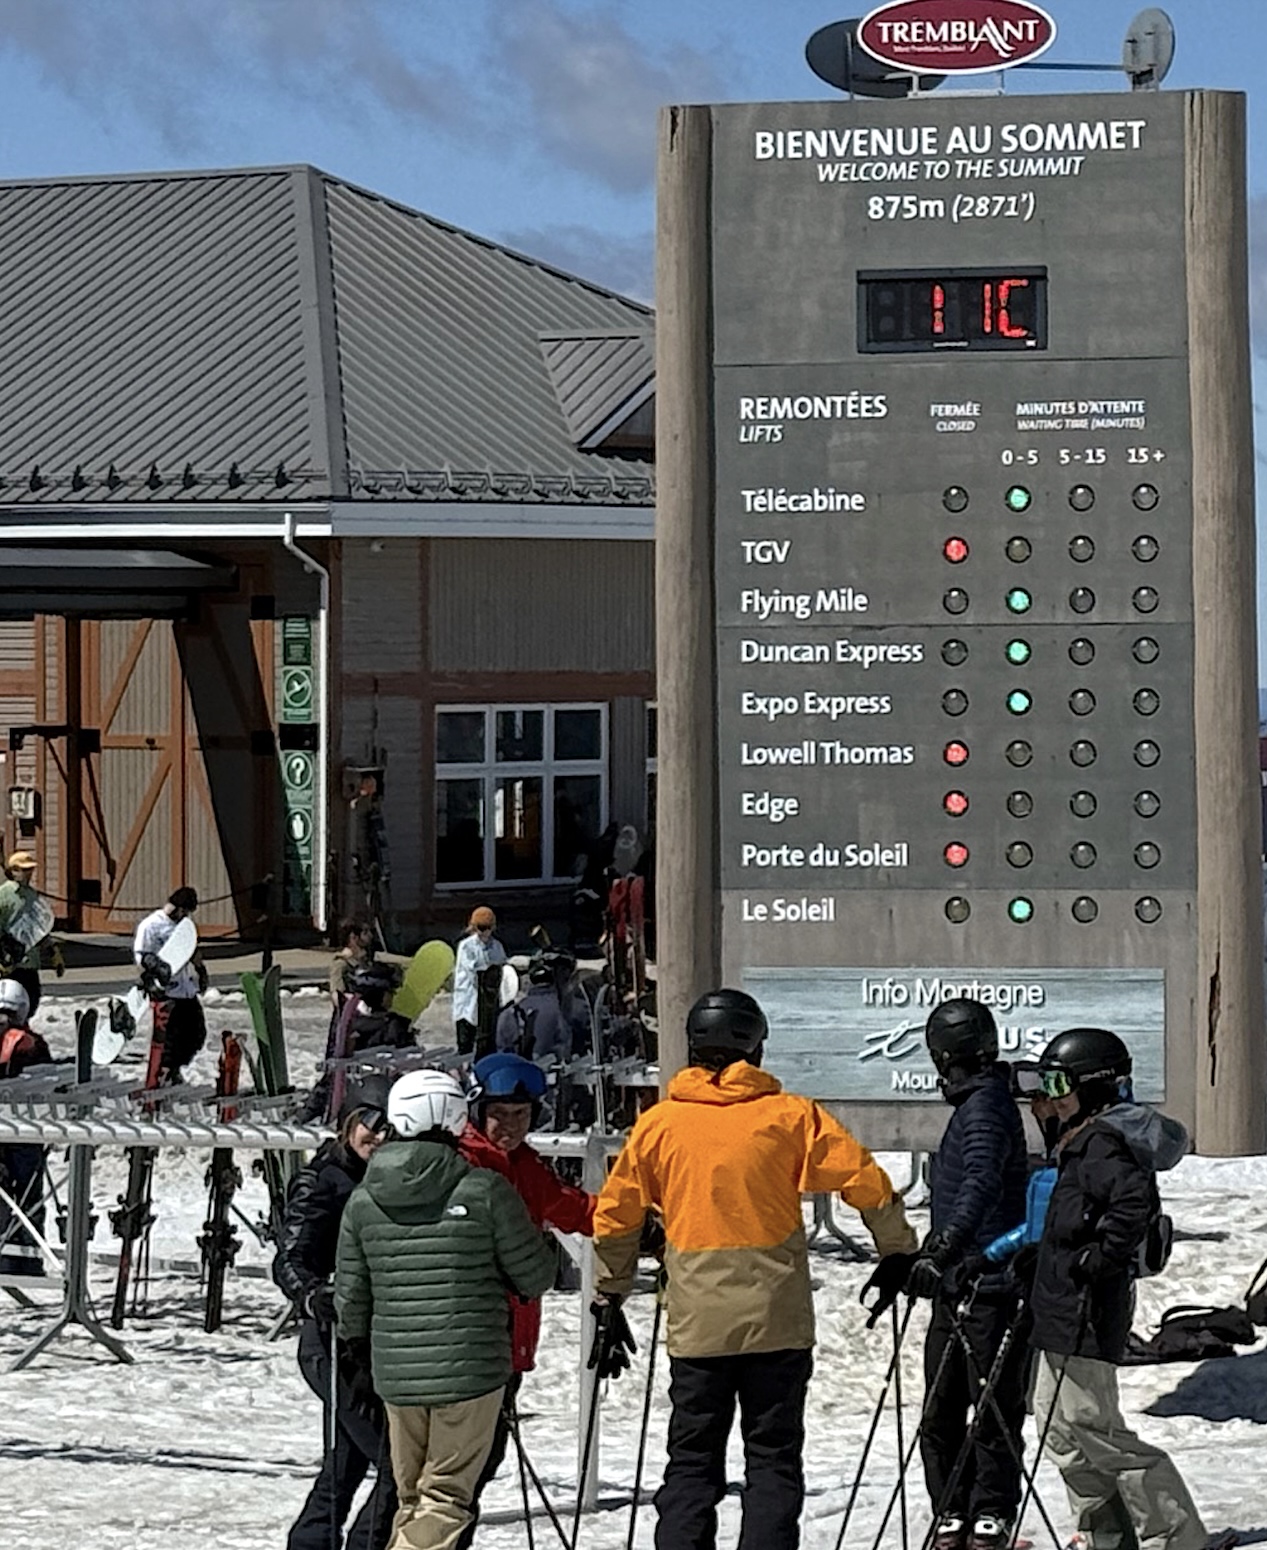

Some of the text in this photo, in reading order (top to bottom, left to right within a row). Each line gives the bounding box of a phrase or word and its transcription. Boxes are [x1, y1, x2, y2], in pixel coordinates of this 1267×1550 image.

[878, 17, 1040, 57] TREMBLANT
[755, 120, 1146, 161] BIENVENUE AU SOMMET
[817, 156, 1085, 182] WELCOME TO THE SUMMIT
[867, 195, 945, 219] 875m
[740, 390, 888, 420] REMONTÉES
[930, 401, 980, 417] FERMÉE
[1016, 401, 1076, 416] MINUTES
[739, 424, 783, 443] LIFTS
[935, 420, 976, 432] CLOSED
[1017, 418, 1063, 430] WAITING
[740, 487, 865, 512] Télécabine
[740, 540, 791, 563] TGV
[741, 587, 868, 620] Flying Mile
[741, 639, 923, 669] Duncan Express
[741, 691, 891, 721] Expo Express
[741, 740, 914, 765] Lowell Thomas
[742, 791, 798, 822] Edge
[742, 842, 908, 867] Porte du Soleil
[742, 897, 835, 922] Le Soleil
[862, 977, 1044, 1010] Info Montagne
